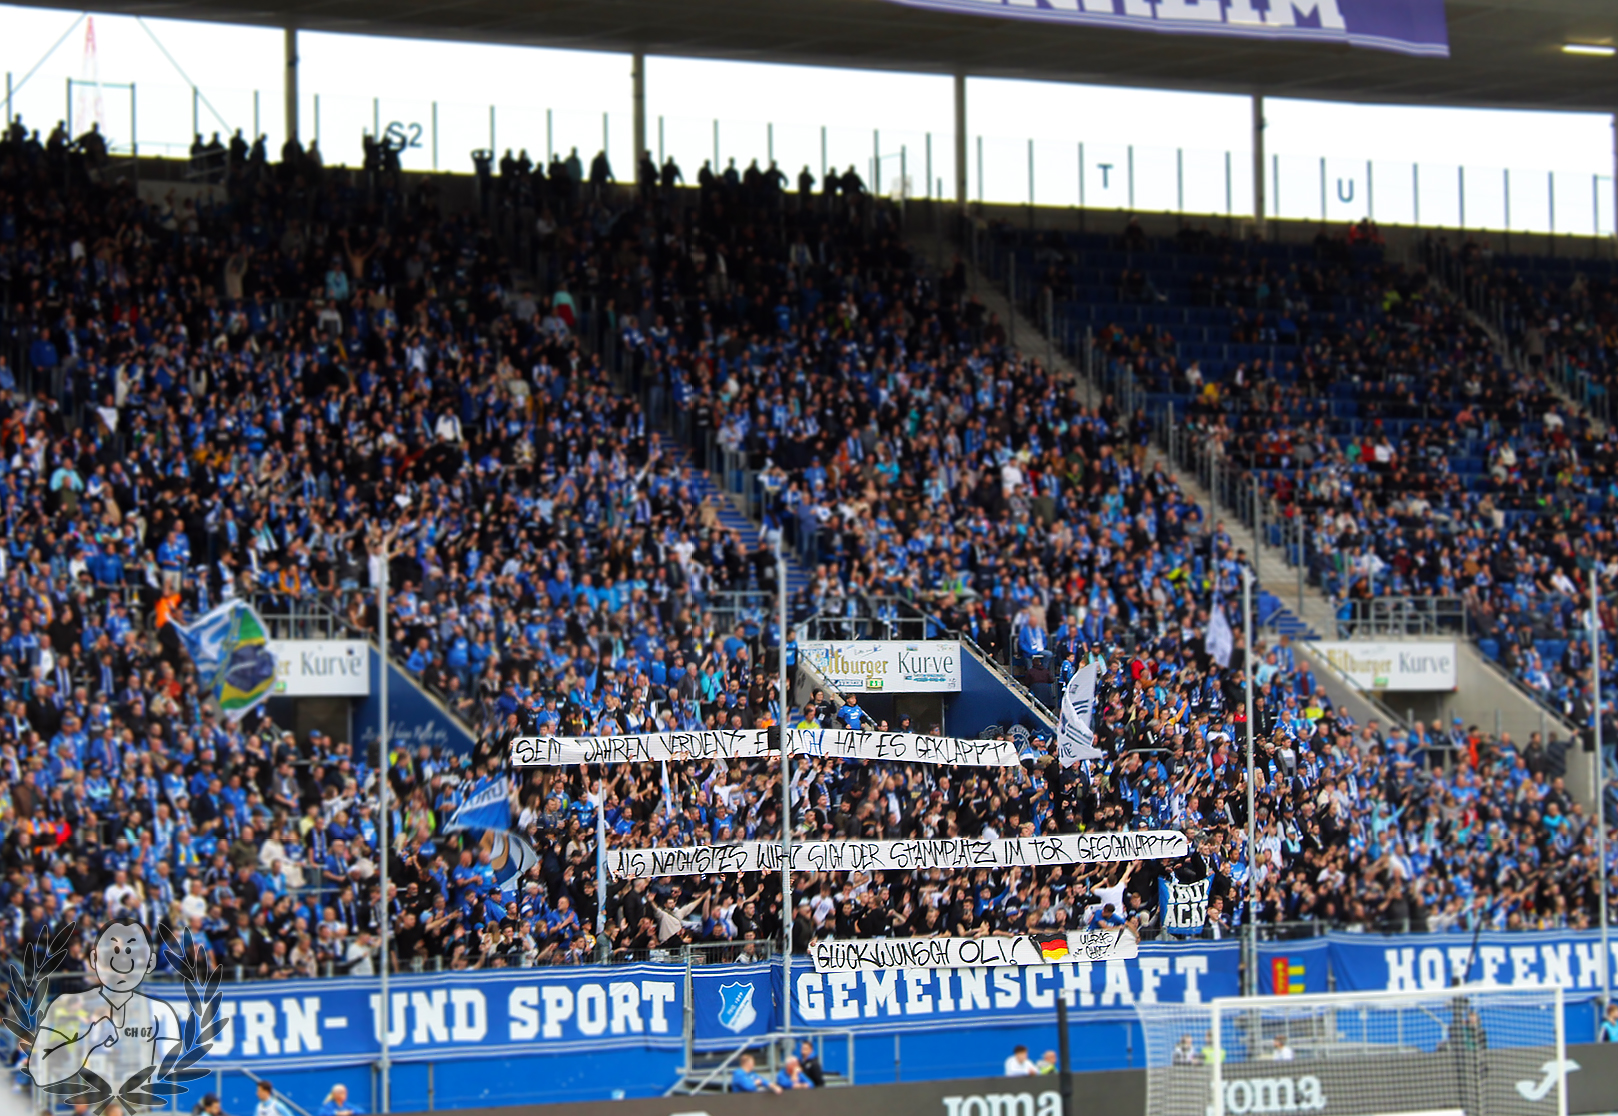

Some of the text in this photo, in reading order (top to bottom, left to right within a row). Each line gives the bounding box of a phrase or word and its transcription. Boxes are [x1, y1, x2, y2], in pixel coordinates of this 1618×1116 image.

[386, 121, 423, 151] S2
[1097, 163, 1114, 189] T
[1337, 178, 1355, 203] U
[301, 651, 362, 676] Kurve
[898, 651, 954, 674] Kurve
[1399, 651, 1450, 674] Kurve
[575, 736, 650, 763] JAHREN
[754, 729, 826, 755] ELICH
[835, 730, 872, 757] HAT
[876, 733, 907, 758] ES
[915, 736, 1008, 764] GEKLAPPT
[808, 843, 846, 871] SICH
[849, 843, 886, 870] DER
[890, 839, 997, 868] STAMMPLATZ
[1004, 839, 1026, 865] IM
[1028, 838, 1072, 863] TOR
[816, 938, 951, 968] GLÜCKWUNSCH
[1385, 943, 1618, 993] HOFFENH
[796, 956, 1208, 1021] GEMEINSCHAFT
[370, 989, 487, 1046] UND
[508, 981, 675, 1041] SPORT
